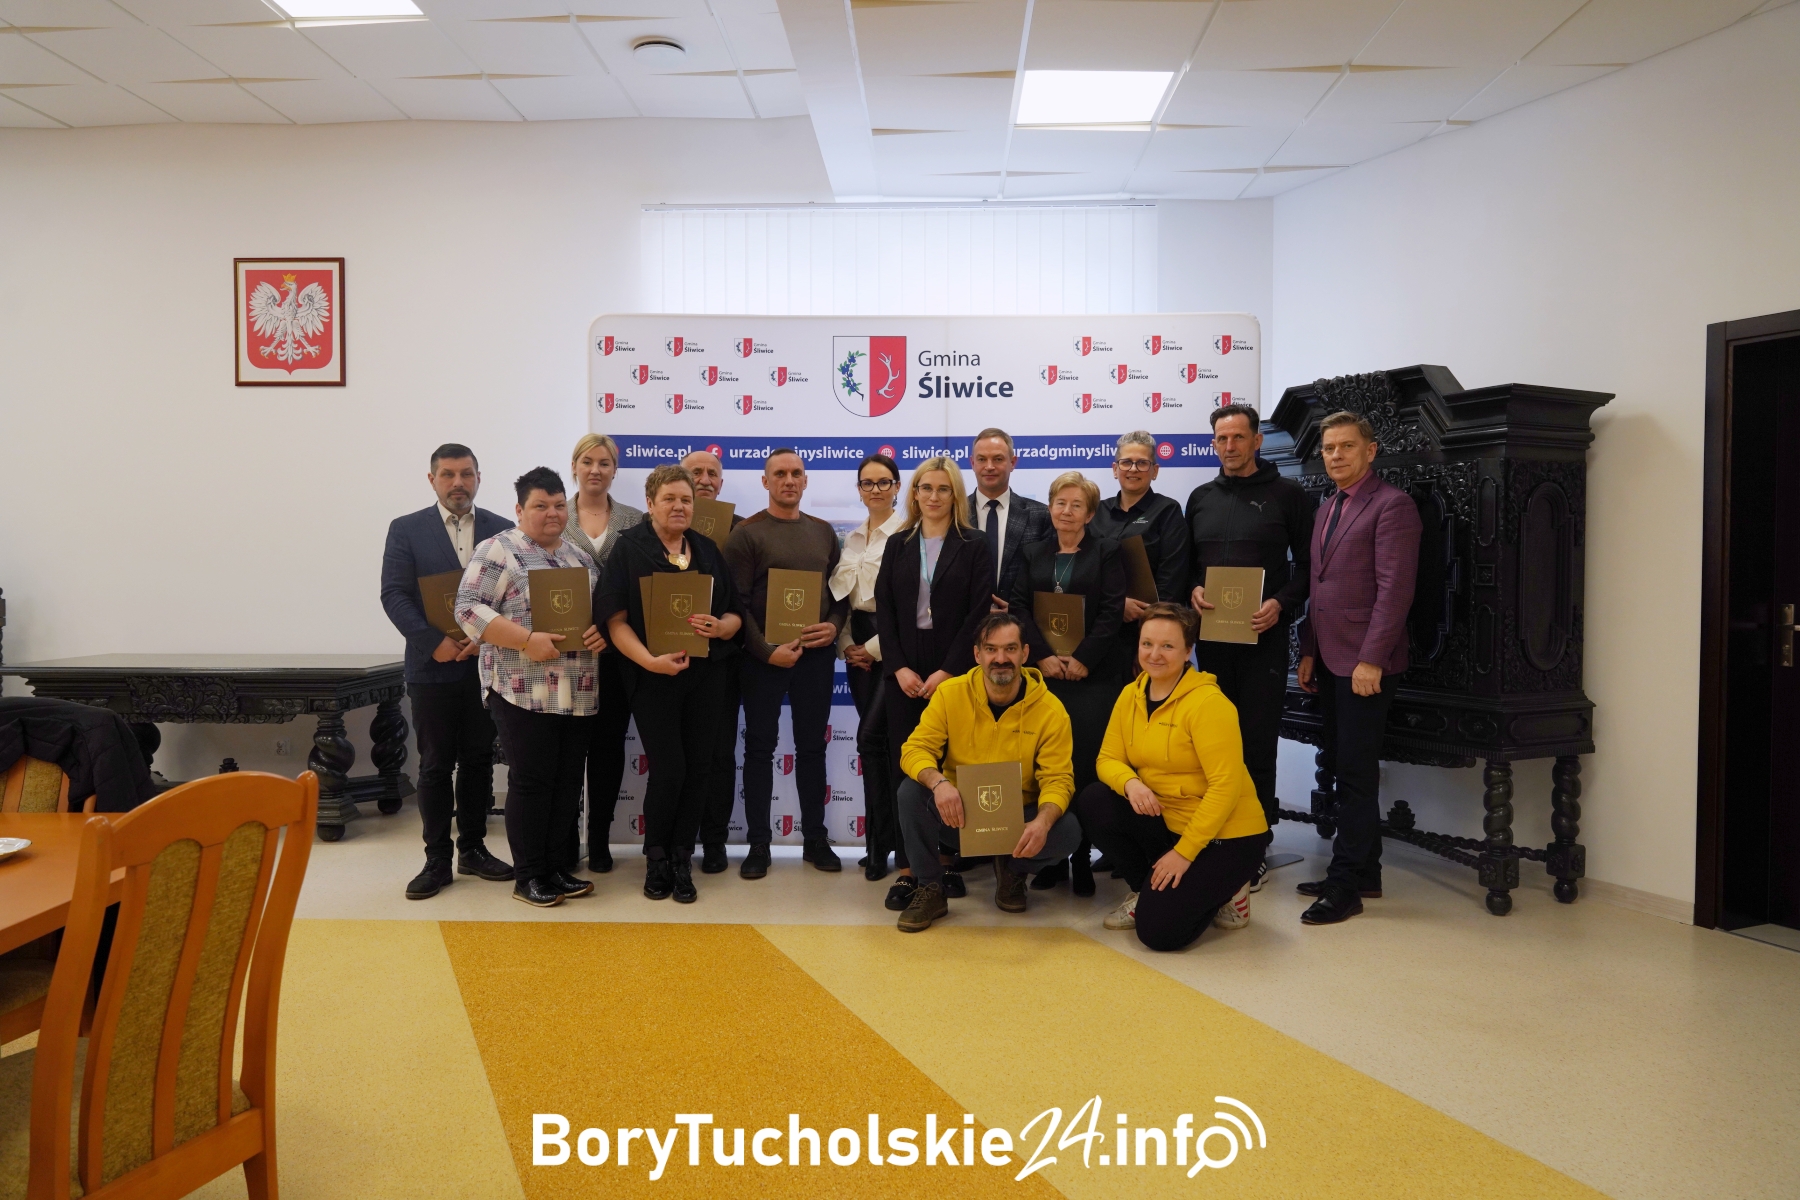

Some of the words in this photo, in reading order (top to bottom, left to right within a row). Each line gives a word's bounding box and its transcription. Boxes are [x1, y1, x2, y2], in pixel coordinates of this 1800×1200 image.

[918, 350, 980, 366] Gmina
[918, 372, 1014, 398] Śliwice
[729, 445, 864, 462] urzadinysliwice
[902, 445, 969, 461] sliwice.pl
[1181, 443, 1218, 456] sliwi
